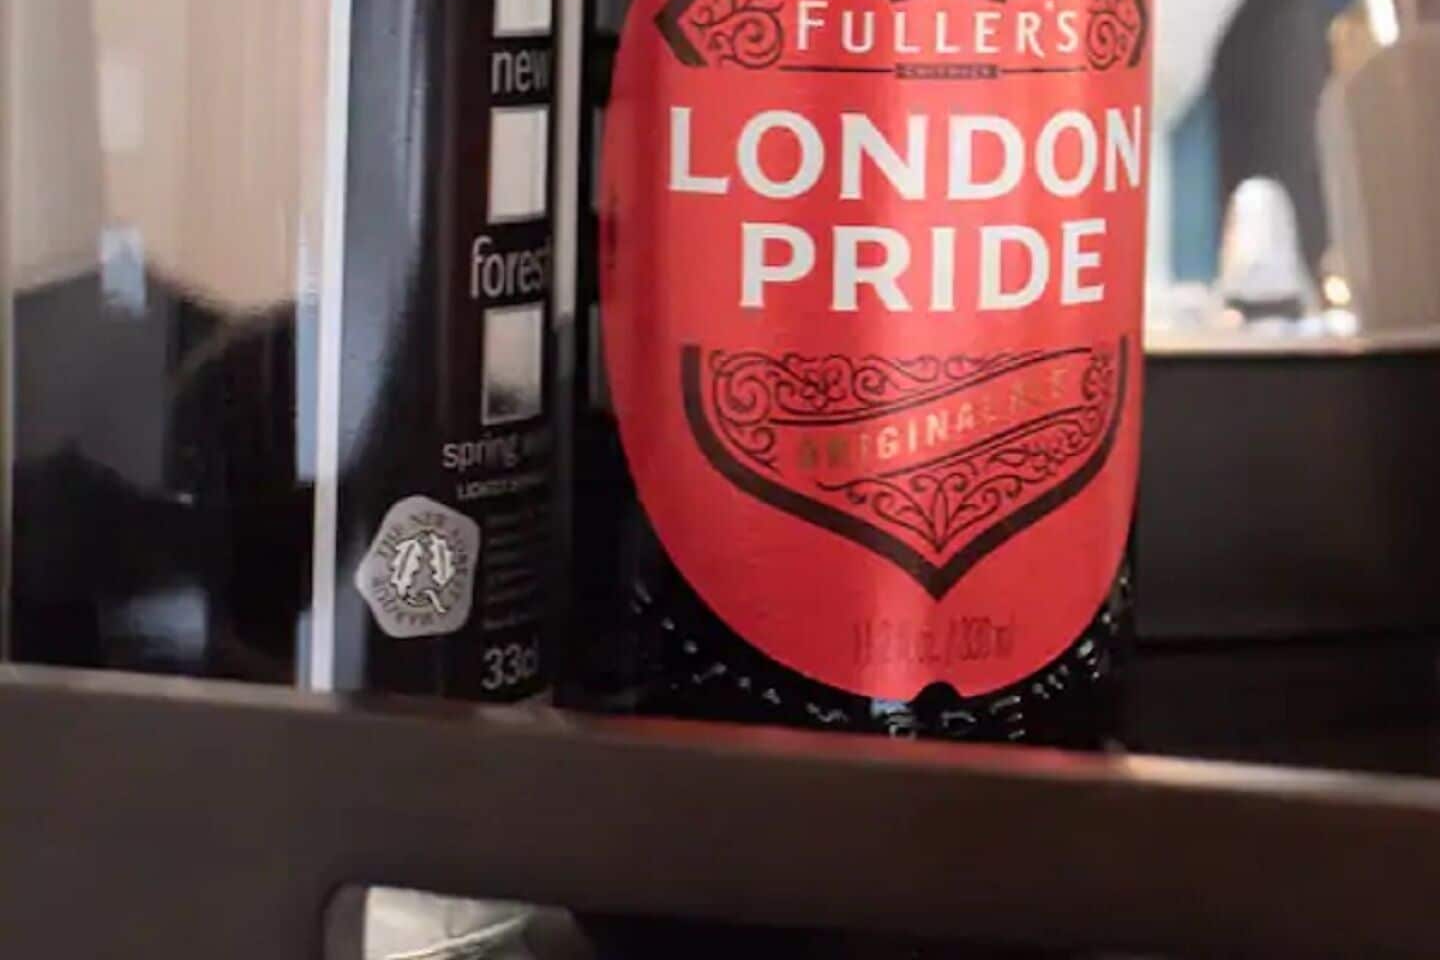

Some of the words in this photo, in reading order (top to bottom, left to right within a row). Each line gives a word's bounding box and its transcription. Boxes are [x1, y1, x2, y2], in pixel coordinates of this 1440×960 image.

[796, 0, 1080, 58] FULLER'S
[668, 105, 1142, 200] LONDON
[740, 217, 1107, 311] PRIDE
